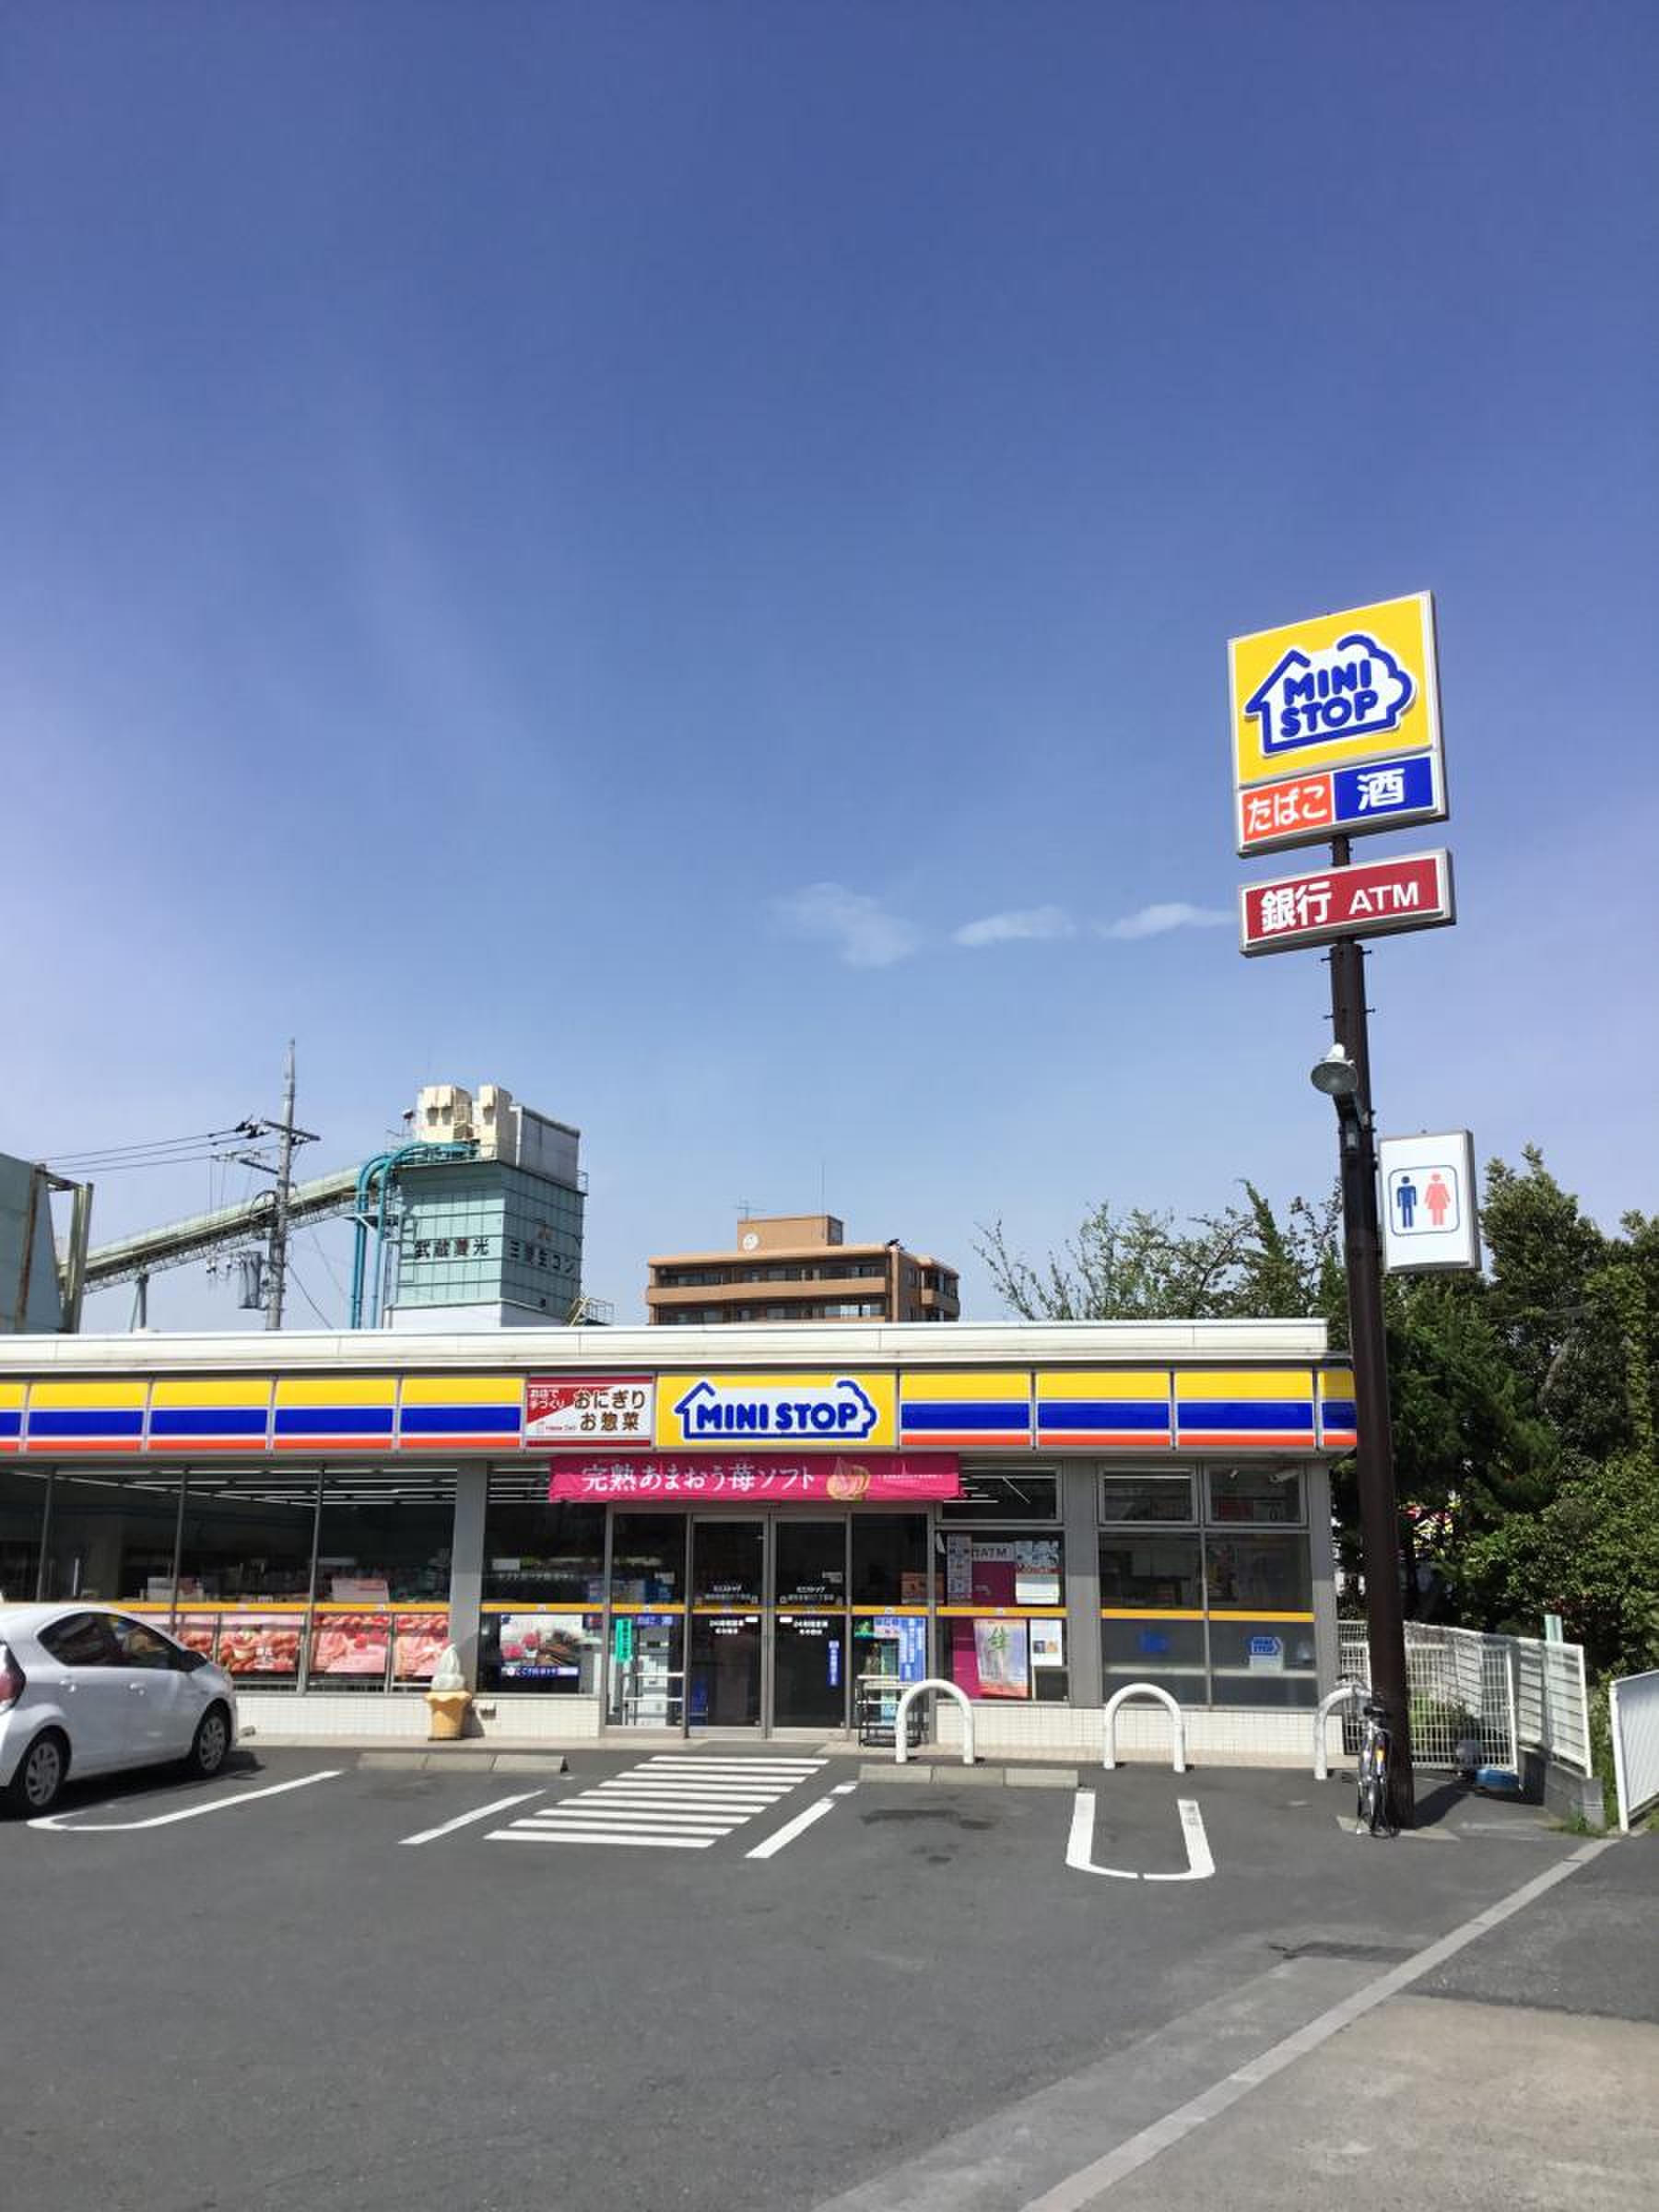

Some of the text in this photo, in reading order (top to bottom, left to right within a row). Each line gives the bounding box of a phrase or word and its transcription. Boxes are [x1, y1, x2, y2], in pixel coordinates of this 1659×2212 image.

[1283, 659, 1372, 707] MINI
[1280, 689, 1379, 738] STOP
[1247, 785, 1328, 834] たばこ
[1357, 768, 1406, 812] 酒
[1260, 881, 1419, 934] 銀行 ATM
[575, 1389, 646, 1409] おにぎり
[696, 1402, 859, 1430] MINI STOP
[580, 1412, 640, 1431] お惣菜
[581, 1463, 815, 1491] 完熟あまおう苺ソフト
